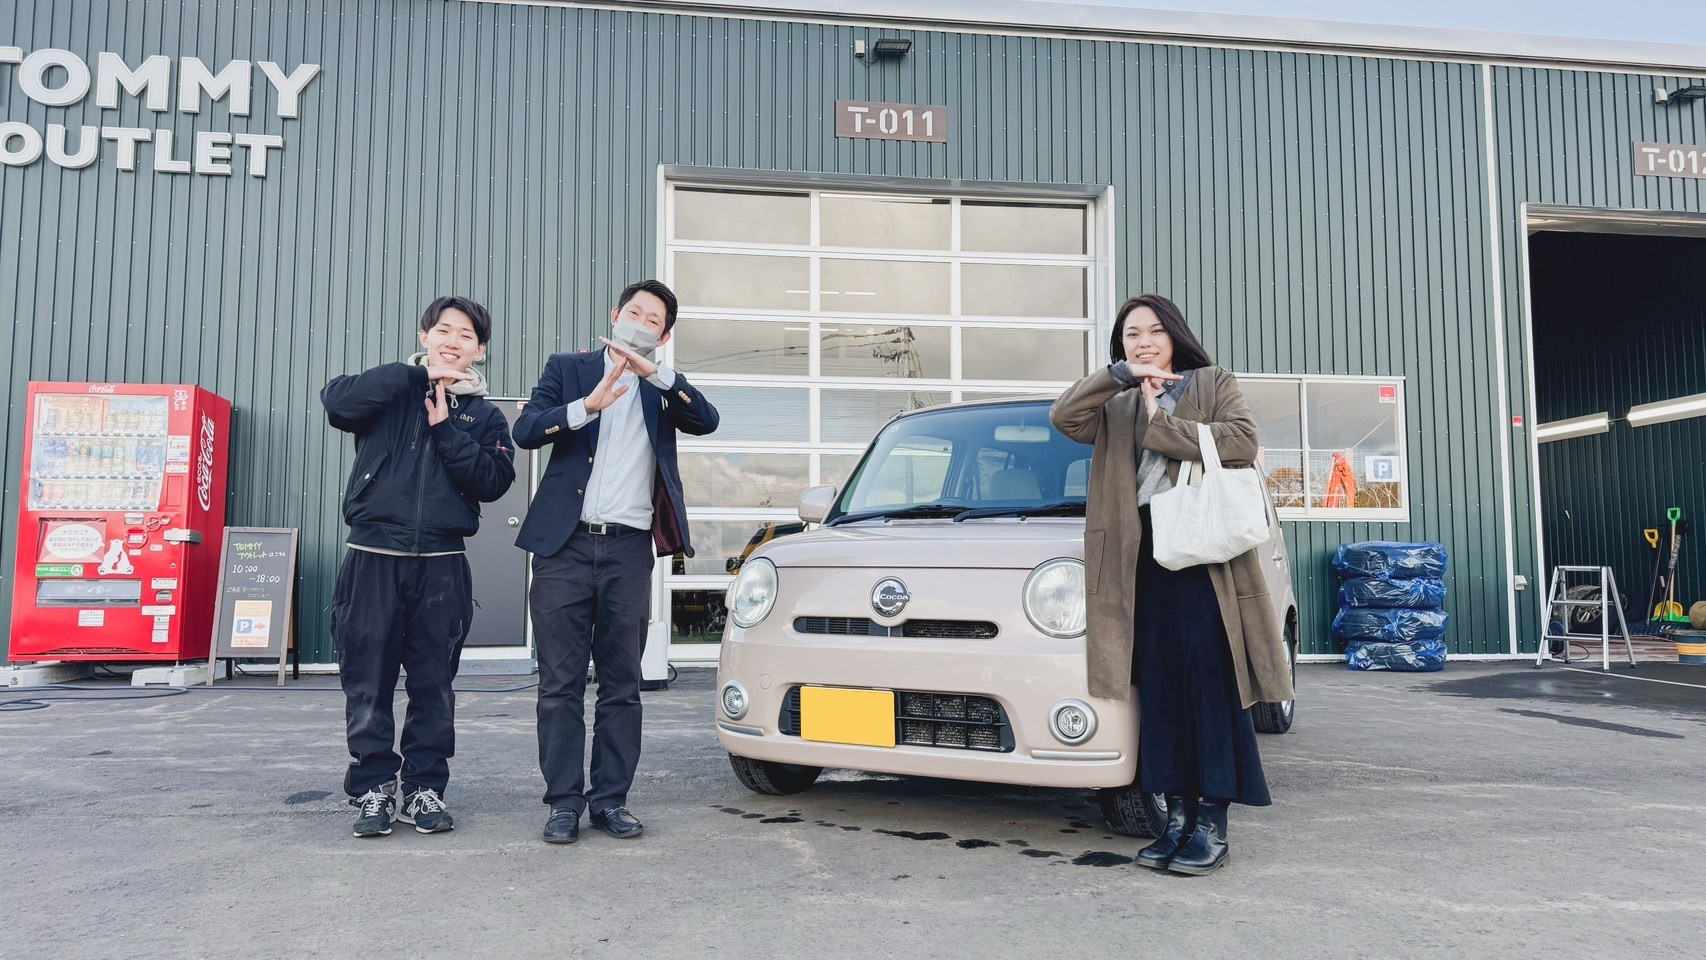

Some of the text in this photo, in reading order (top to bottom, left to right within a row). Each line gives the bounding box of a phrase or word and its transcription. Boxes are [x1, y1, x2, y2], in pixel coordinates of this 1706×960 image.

[847, 106, 933, 136] T-011
[0, 121, 283, 177] OUTLET
[233, 542, 262, 551] TOMMY
